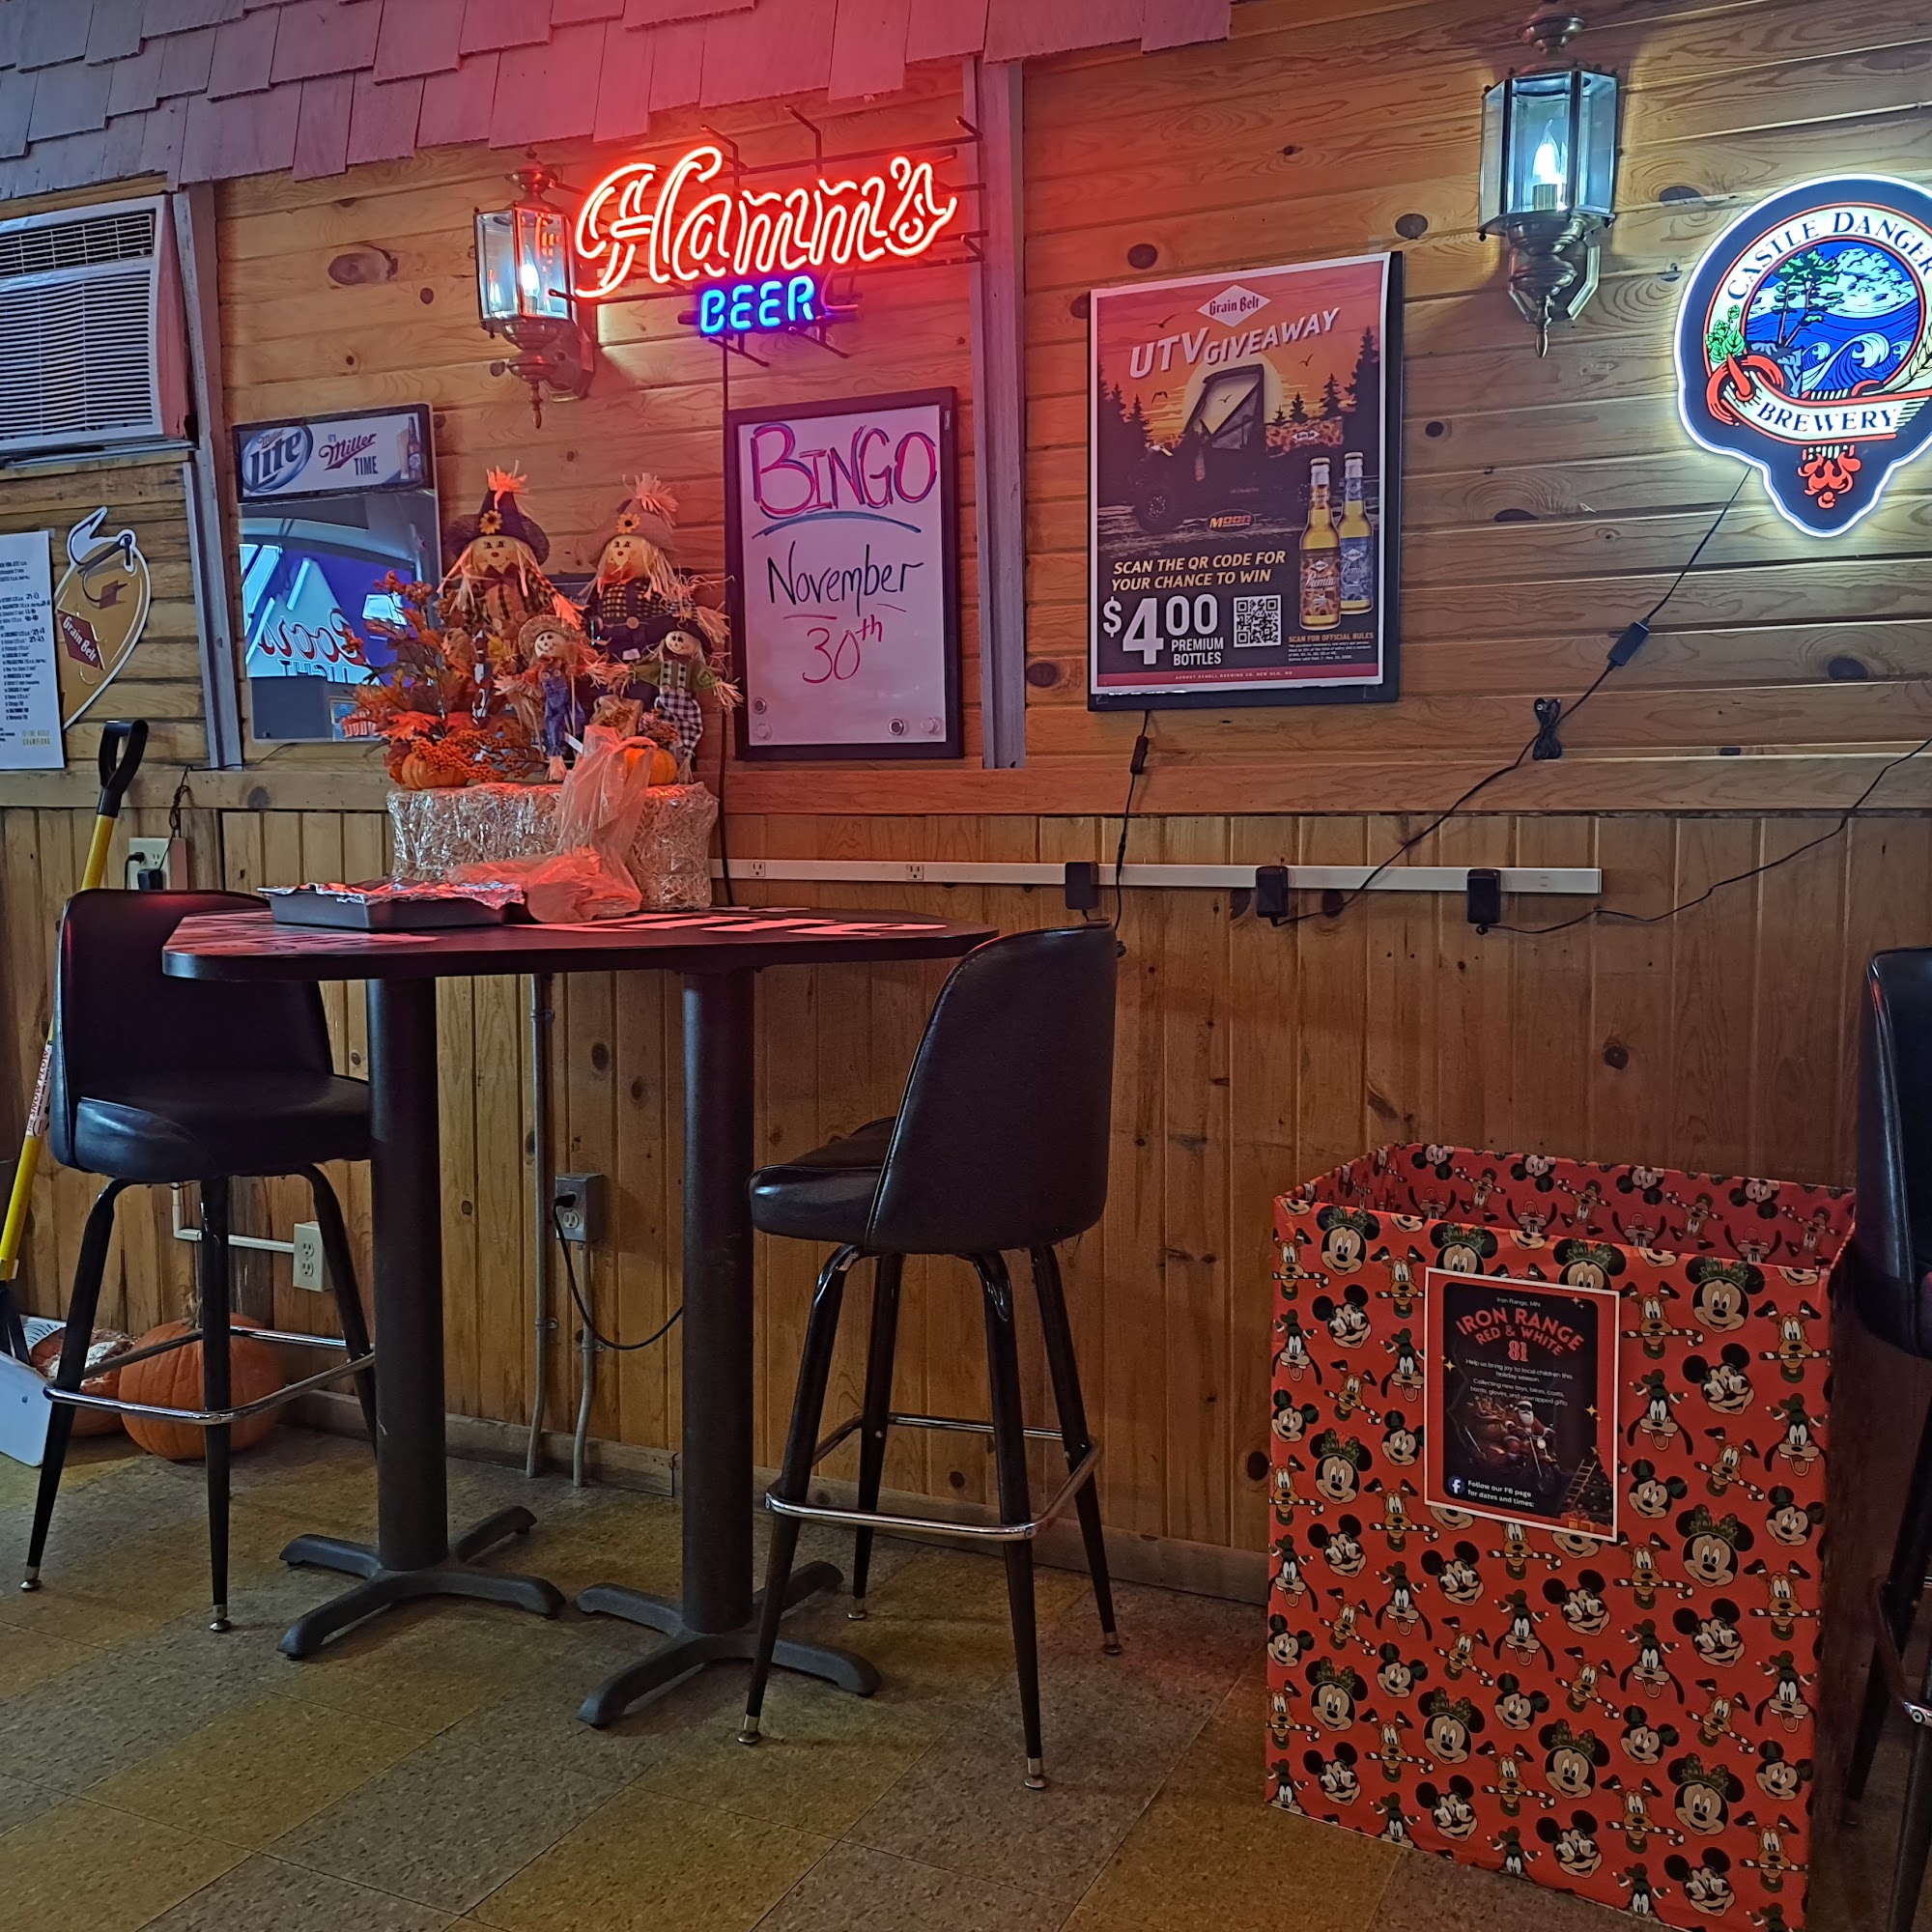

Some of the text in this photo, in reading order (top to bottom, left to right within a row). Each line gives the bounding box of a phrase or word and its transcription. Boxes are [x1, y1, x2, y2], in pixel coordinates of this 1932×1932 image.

[575, 146, 957, 298] Hamm's
[1726, 219, 1819, 300] CASTLE
[699, 274, 815, 334] BEER
[1209, 296, 1259, 316] Grain Belt
[1129, 307, 1341, 379] UTV GIVEAWAY
[1756, 402, 1898, 433] BREWERY
[319, 434, 377, 470] Miller
[354, 456, 379, 475] TIME
[751, 422, 937, 520] BINGO
[1113, 550, 1286, 575] SCAN THE QR CODE FOR
[767, 541, 923, 616] November
[1111, 569, 1271, 592] YOUR CHANCE TO WIN
[63, 616, 97, 662] Grain Belt
[802, 613, 883, 684] 30th
[1171, 637, 1224, 652] PREMIUM
[1321, 633, 1350, 641] OFFICIAL
[1173, 651, 1222, 667] BOTTLES
[30, 1084, 42, 1117] SNOW
[1456, 1307, 1584, 1351] IRON RANGE
[1475, 1324, 1564, 1356] RED & WHITE
[1508, 1340, 1528, 1362] 81
[1465, 1358, 1480, 1367] Help
[1488, 1362, 1503, 1371] bring
[1536, 1369, 1561, 1378] children
[1495, 1371, 1517, 1380] holiday
[1472, 1378, 1501, 1389] Collecting
[1467, 1480, 1491, 1491] Follow
[1514, 1490, 1532, 1498] page
[1478, 1492, 1498, 1500] dates
